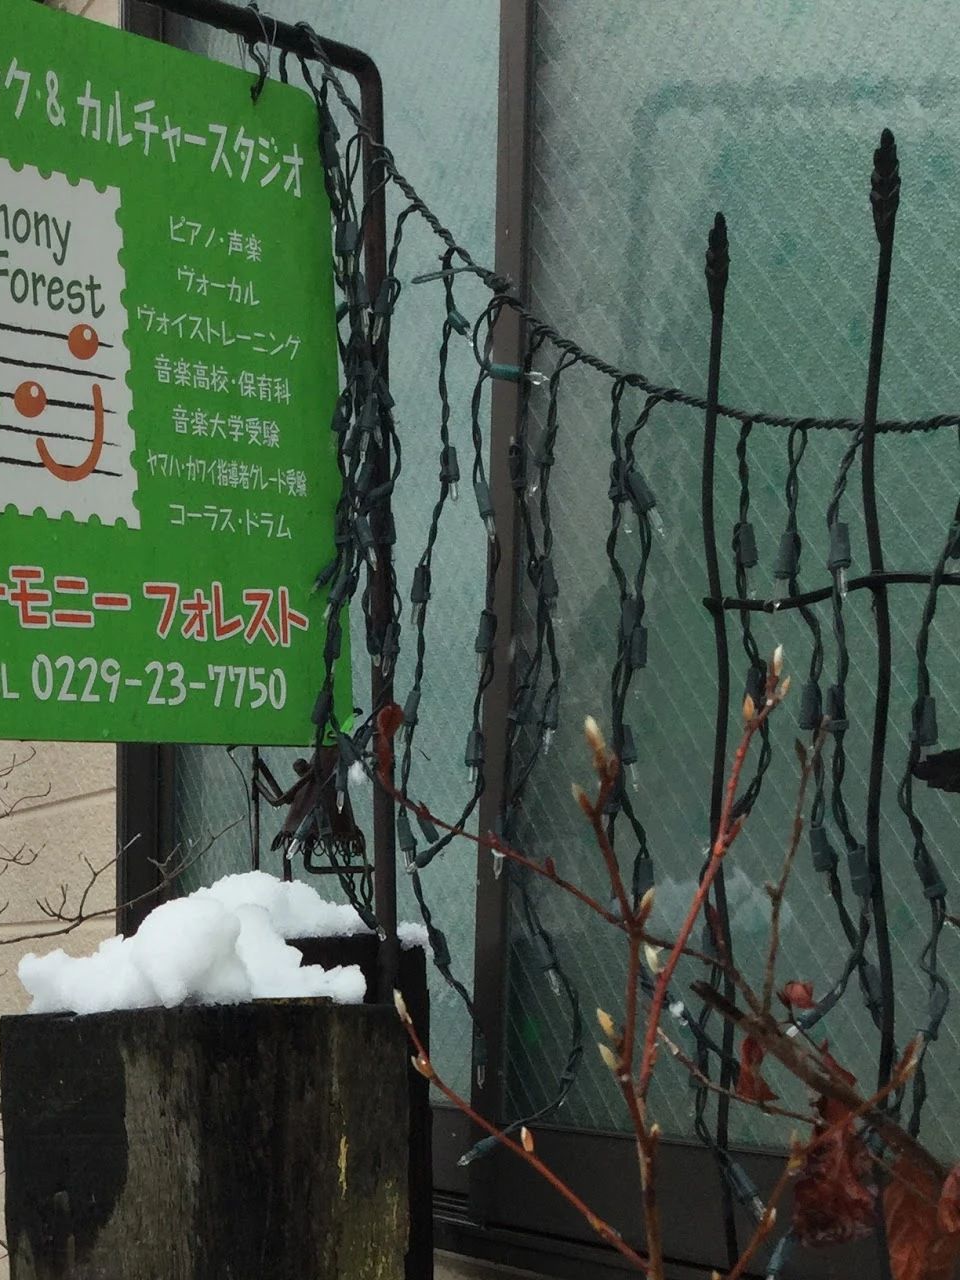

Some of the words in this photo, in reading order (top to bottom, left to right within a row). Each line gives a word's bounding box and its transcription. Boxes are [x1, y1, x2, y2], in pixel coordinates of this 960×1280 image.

[76, 80, 304, 198] カルチャースタジオ
[170, 215, 262, 262] ピアノ・声楽
[177, 265, 260, 305] ヴォーカル
[137, 304, 301, 360] ヴォイストレーニング
[172, 404, 280, 448] 音楽大学受験
[142, 581, 309, 647] フォレスト
[31, 653, 287, 711] 0229-23-7750
